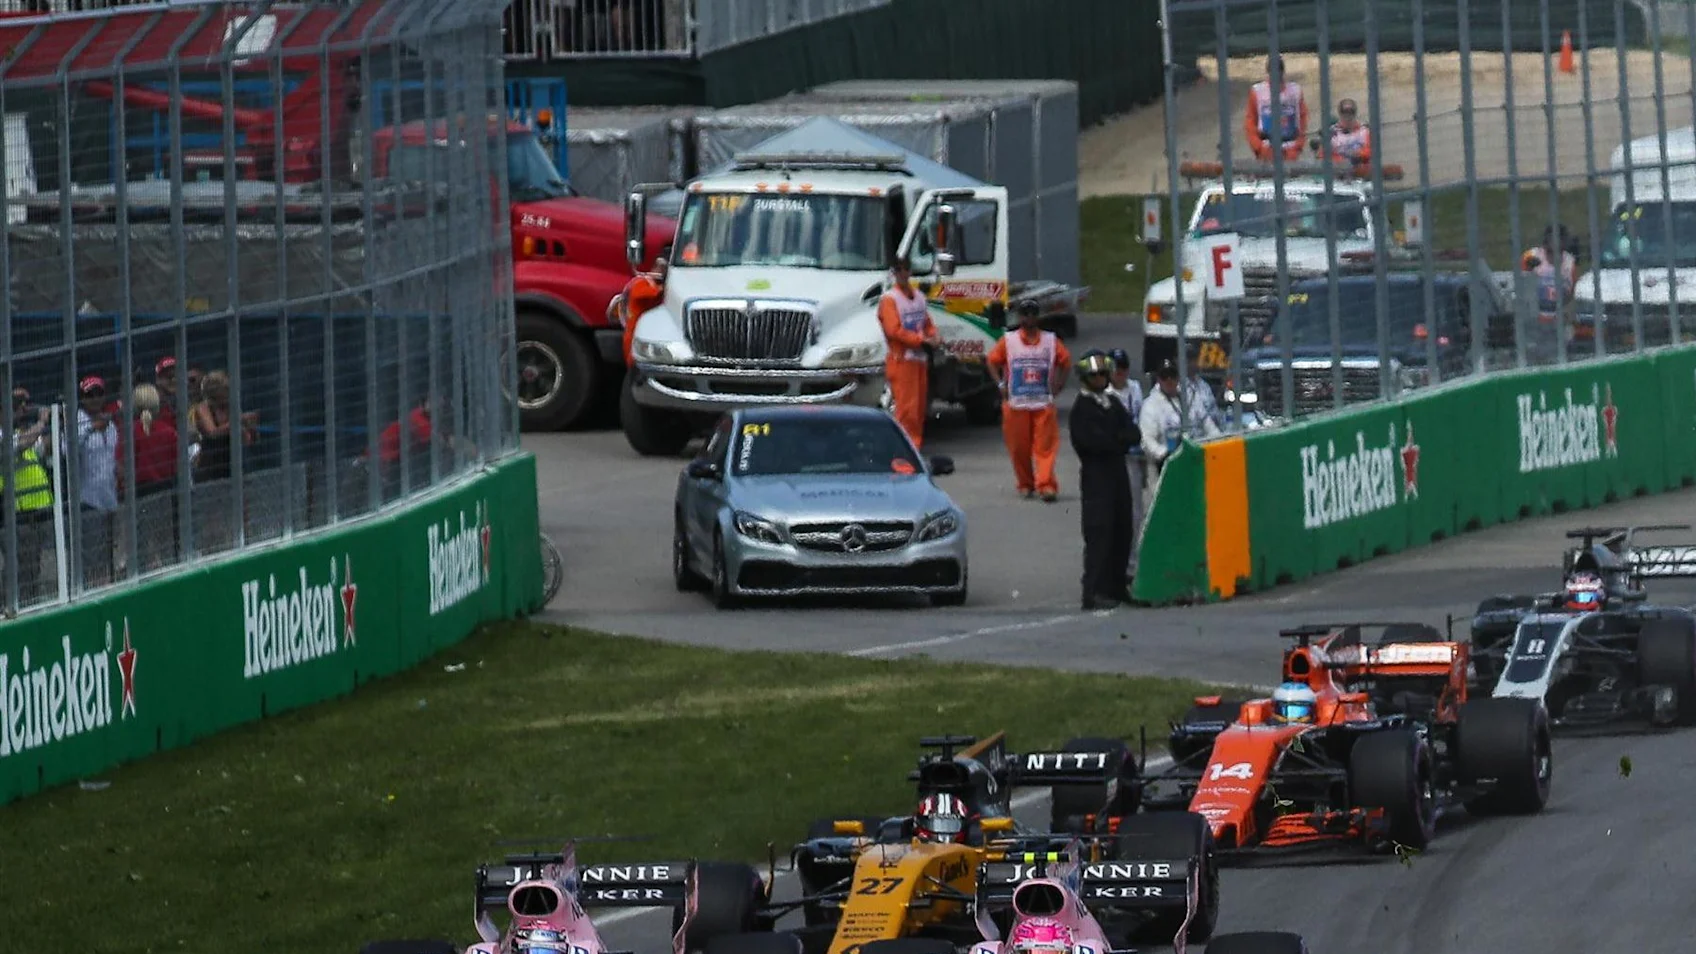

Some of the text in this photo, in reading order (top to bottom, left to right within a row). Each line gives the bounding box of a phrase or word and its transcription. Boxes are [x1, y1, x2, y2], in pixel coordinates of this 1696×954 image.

[1211, 245, 1232, 287] F
[1517, 387, 1600, 472] Heineken
[1300, 431, 1396, 529] Heineken
[427, 510, 483, 616] Heineken
[241, 566, 338, 679] Heineken
[1027, 753, 1106, 770] NITI
[1210, 762, 1254, 781] 14
[506, 866, 670, 886] JNNIE
[1006, 864, 1171, 883] JNNIE
[595, 888, 664, 900] KER
[856, 878, 904, 895] 27
[1095, 886, 1163, 897] KER
